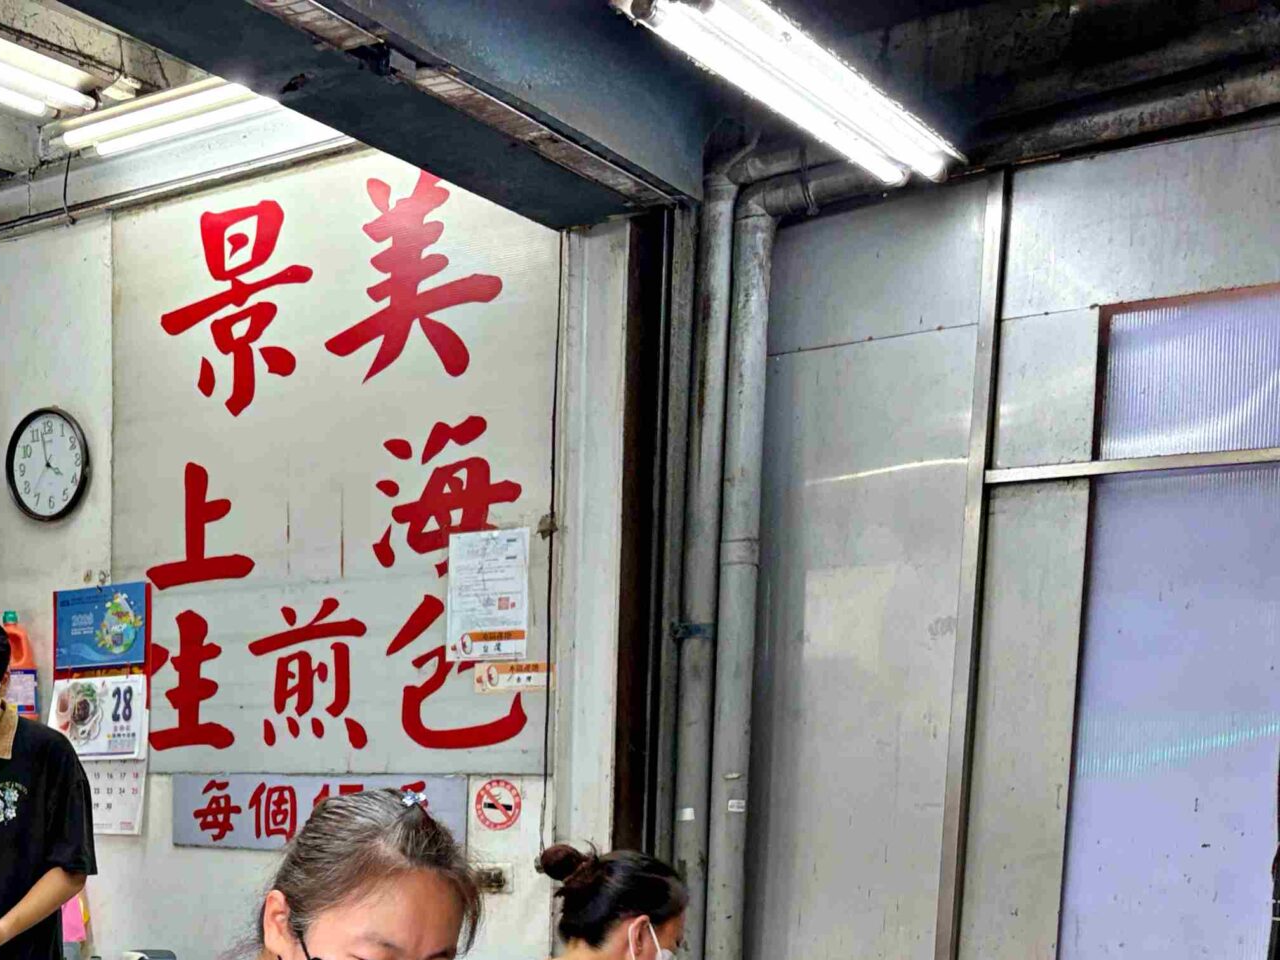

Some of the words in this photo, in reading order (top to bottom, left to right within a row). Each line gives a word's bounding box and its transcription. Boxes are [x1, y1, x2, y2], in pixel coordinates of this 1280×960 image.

[112, 685, 133, 722] 28
[148, 594, 528, 751] 生煎包
